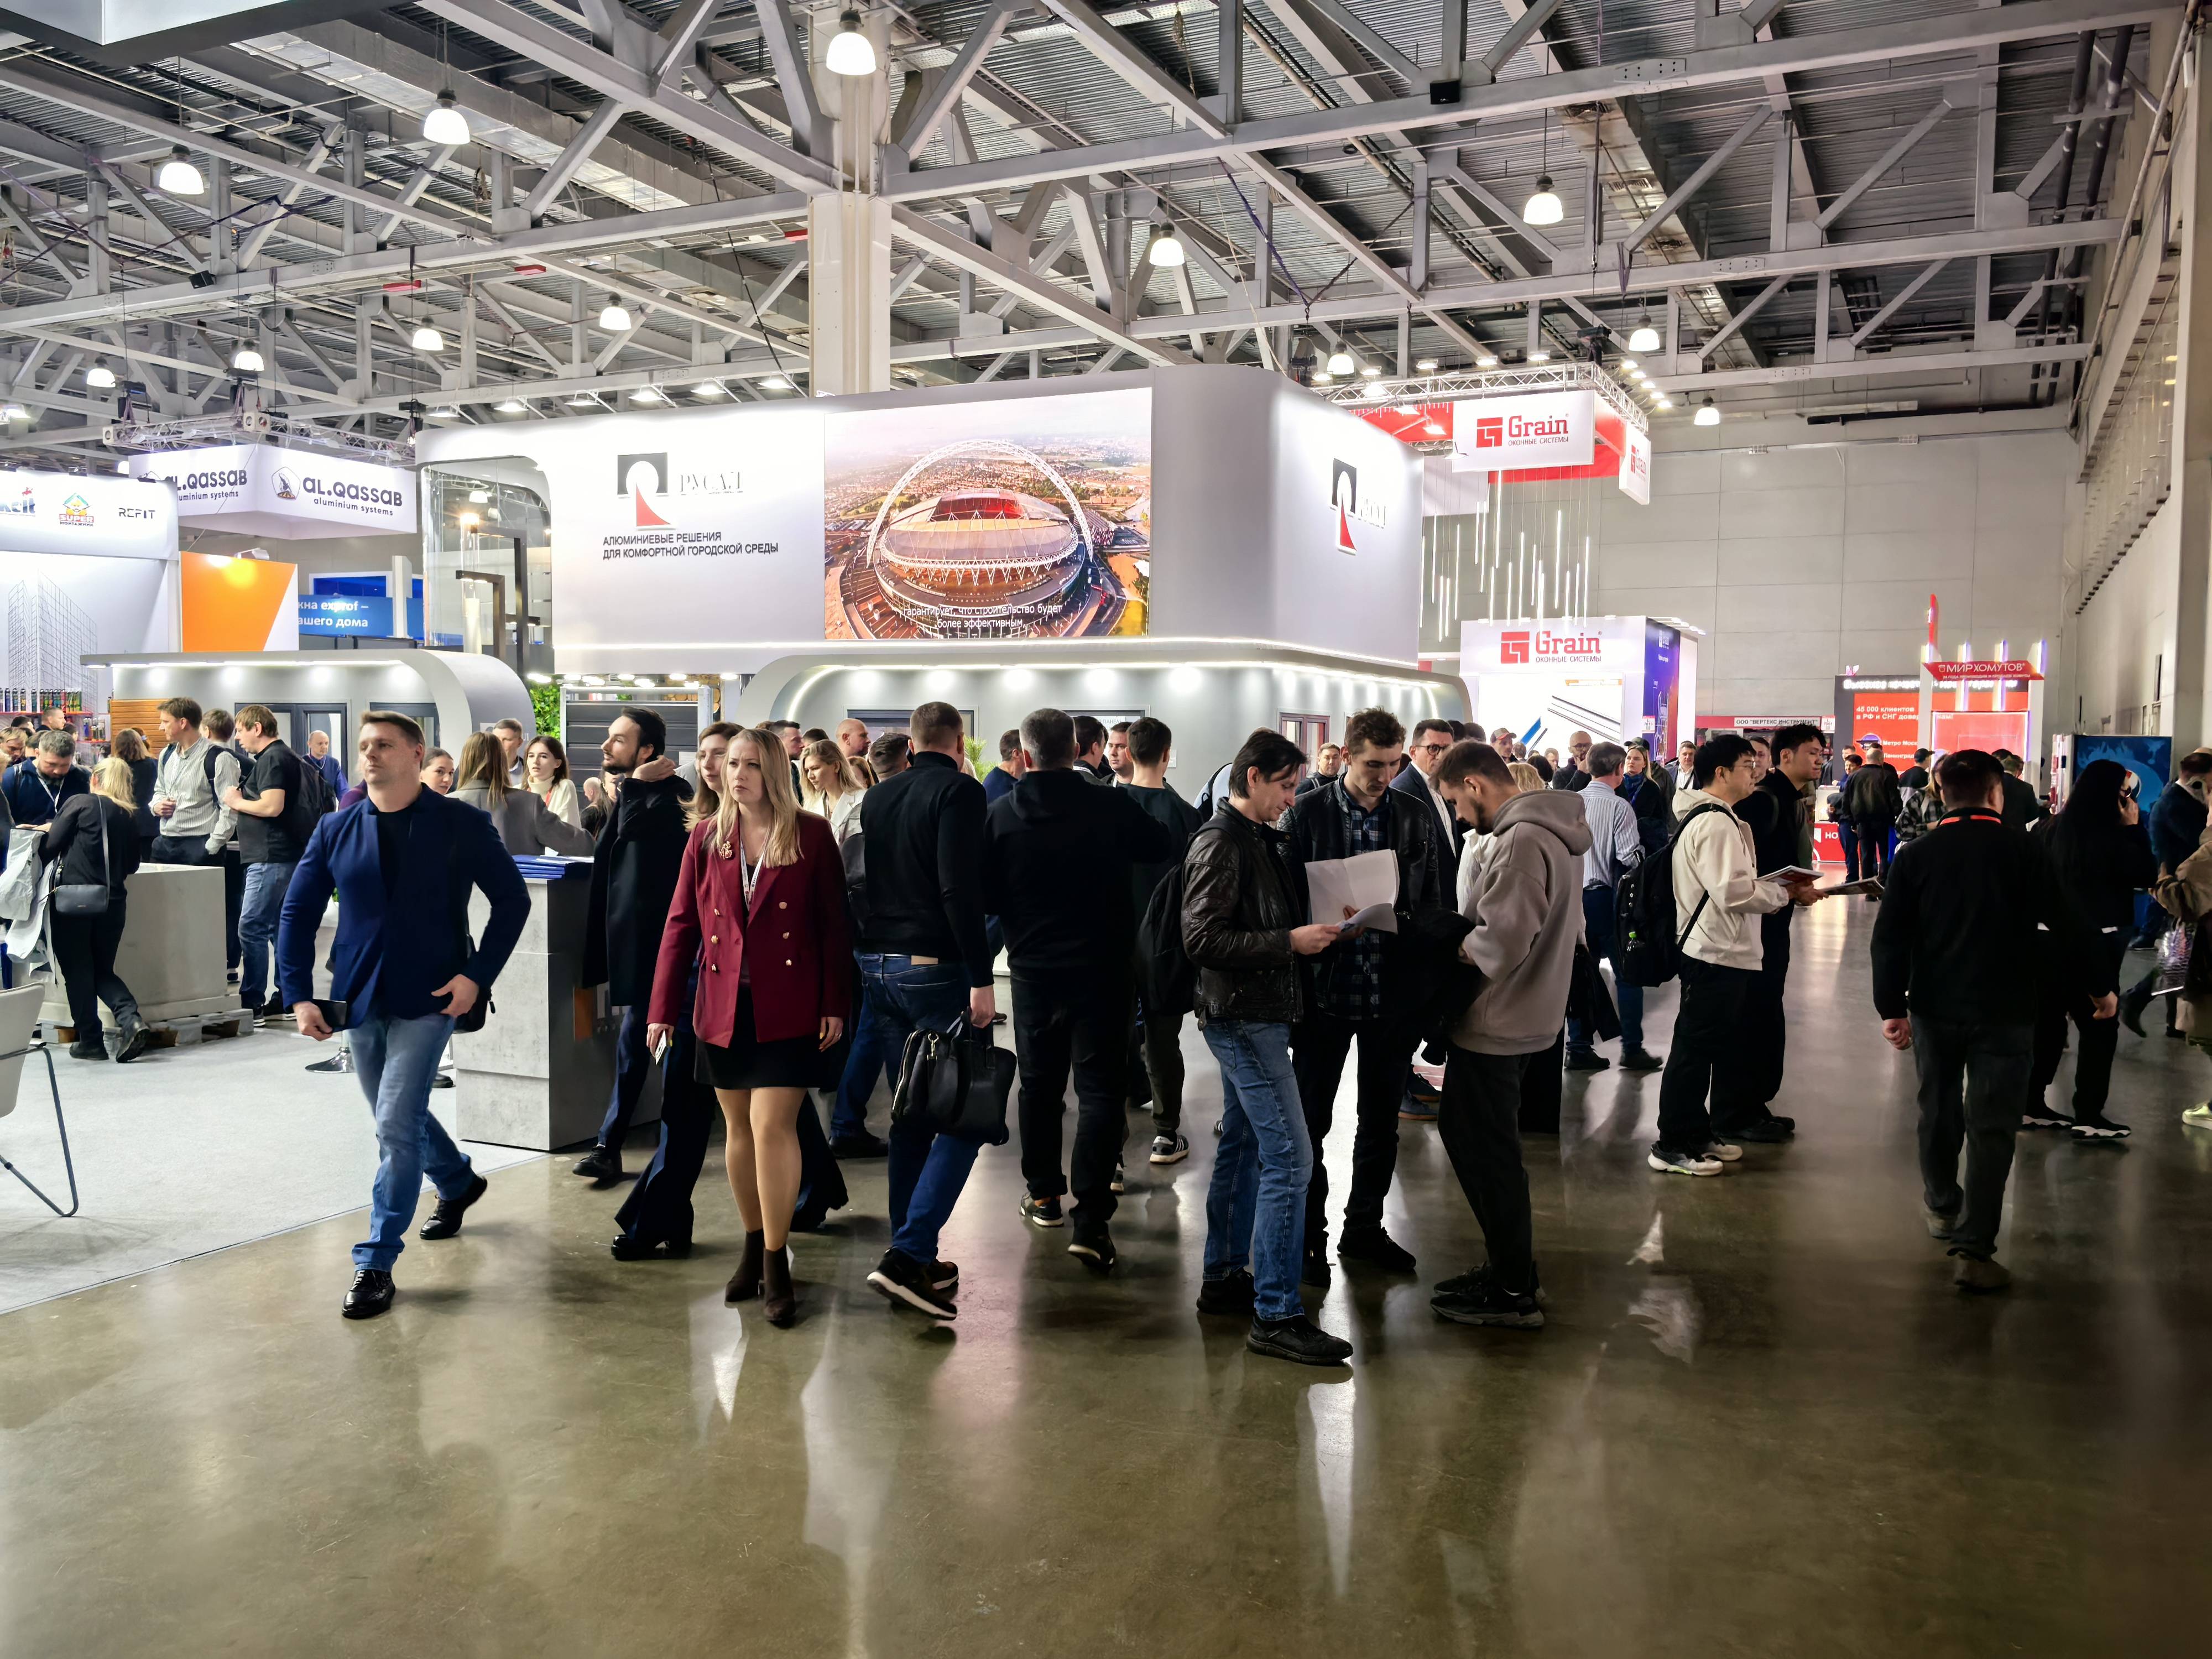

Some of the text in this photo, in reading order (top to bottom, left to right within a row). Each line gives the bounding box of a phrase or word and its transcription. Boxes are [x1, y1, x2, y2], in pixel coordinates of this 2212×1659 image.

[1509, 415, 1568, 437] Grain
[179, 491, 238, 501] uminium systems
[314, 497, 393, 516] aluminium systems
[59, 514, 94, 523] SUPER
[119, 508, 155, 519] REFIT
[603, 532, 722, 546] АЛЮМИНИЕВЫЕ РЕШЕНИЯ
[603, 542, 779, 560] ДЛЯ КОМФОРТНОЙ ГОРОДСКОЙ СРЕДЫ
[298, 601, 318, 609] кна
[975, 604, 1035, 616] строительство
[1037, 603, 1062, 614] будет
[298, 617, 368, 628] ашего дома
[937, 618, 1025, 629] более эффективным,
[1536, 630, 1601, 654] Grain
